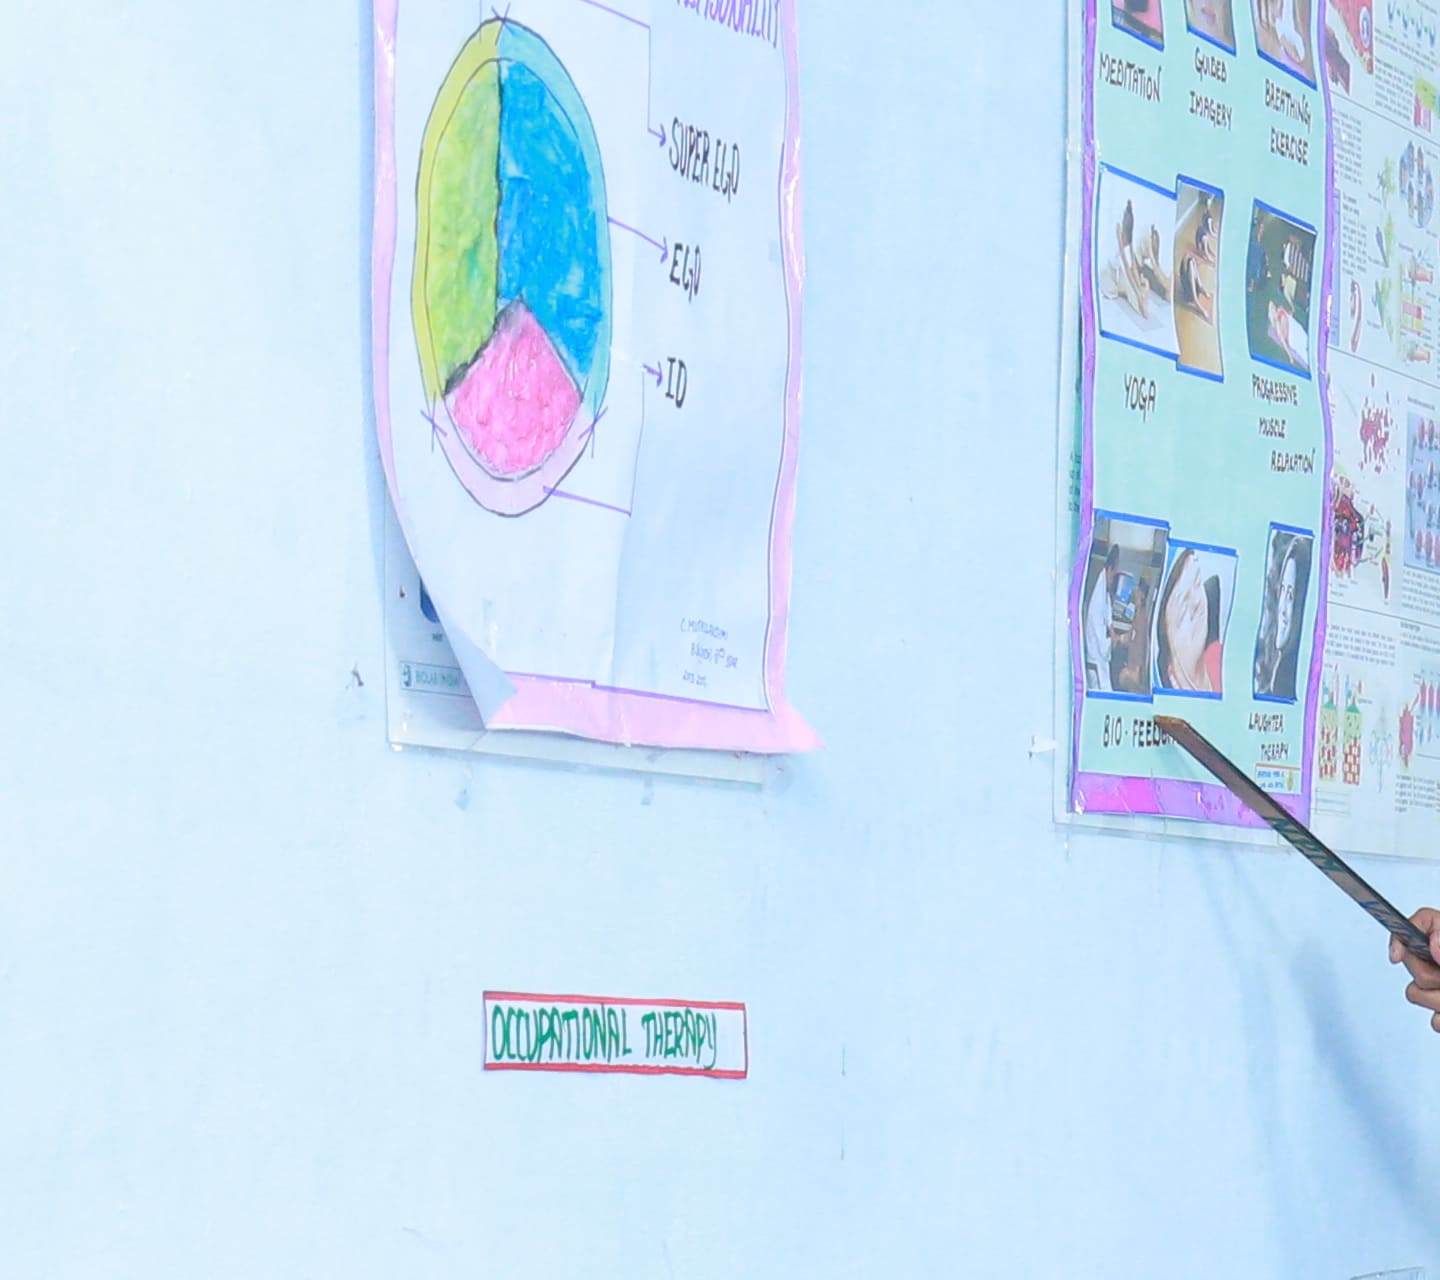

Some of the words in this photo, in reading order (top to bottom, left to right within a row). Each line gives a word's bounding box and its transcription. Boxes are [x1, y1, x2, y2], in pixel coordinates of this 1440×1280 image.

[1099, 51, 1162, 102] MEDITATION
[1194, 47, 1227, 82] GUIDED
[1189, 90, 1233, 131] IMAGERY
[1265, 78, 1311, 134] BREATHING
[669, 116, 709, 187] SUPER
[712, 138, 740, 203] EGO
[1270, 127, 1309, 166] EXERCISE
[669, 242, 701, 303] EGO
[665, 356, 687, 408] ID
[1124, 372, 1157, 423] YOGA
[1252, 373, 1298, 406] PROGRESSIVE
[1258, 417, 1286, 438] MUSCLE
[1103, 713, 1122, 748] BIO
[1248, 711, 1285, 735] LAUGHTER
[1260, 742, 1289, 762] THERAPY
[492, 1002, 632, 1063] OCCUPATIONAL
[641, 1006, 717, 1070] THERAPY
